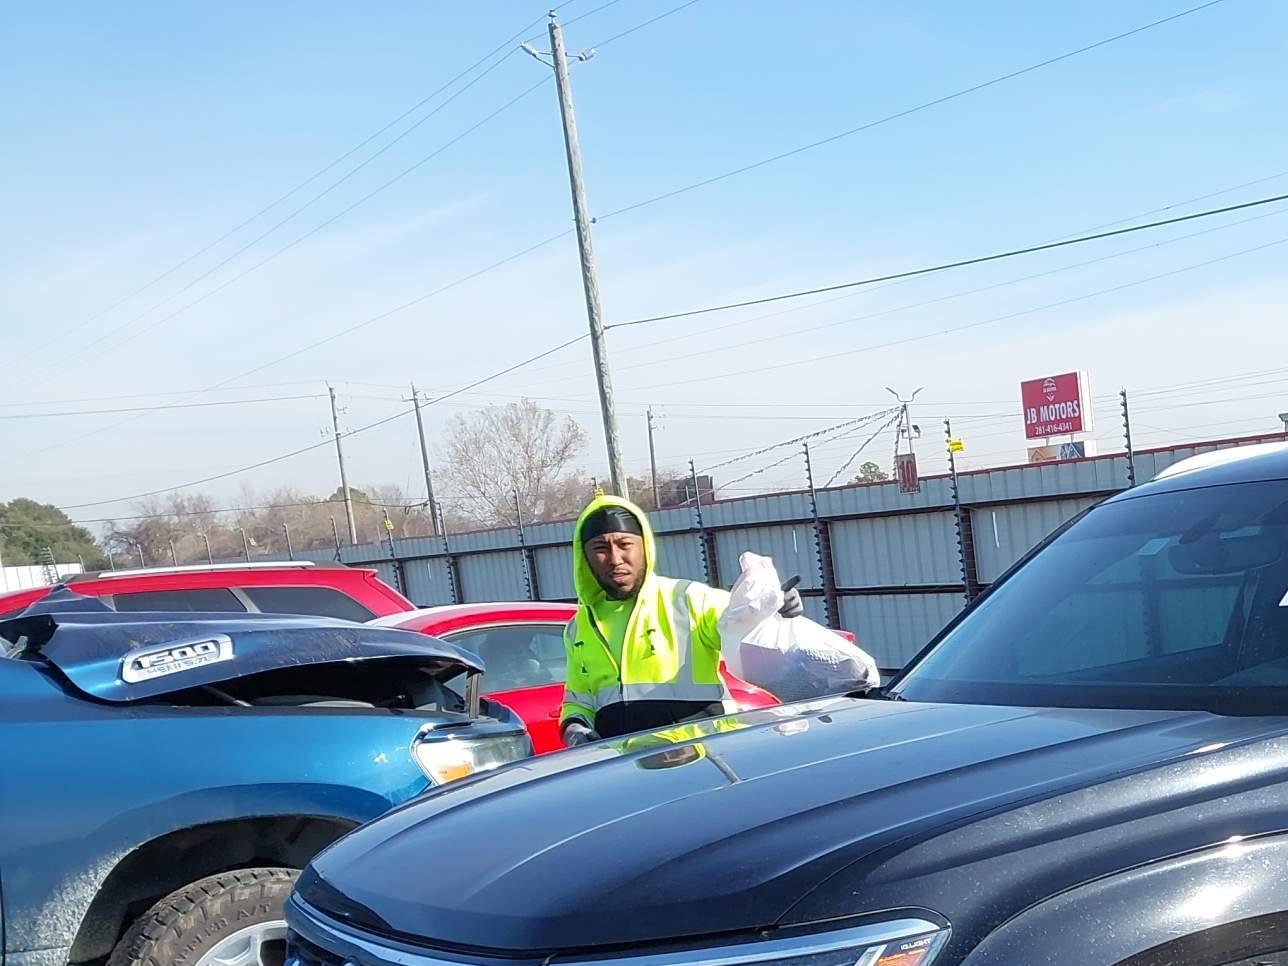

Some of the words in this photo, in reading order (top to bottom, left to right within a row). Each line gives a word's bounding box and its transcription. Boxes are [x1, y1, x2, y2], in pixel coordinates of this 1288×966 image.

[1026, 407, 1037, 424] JB
[1040, 400, 1080, 423] MOTORS
[136, 641, 217, 670] 1500
